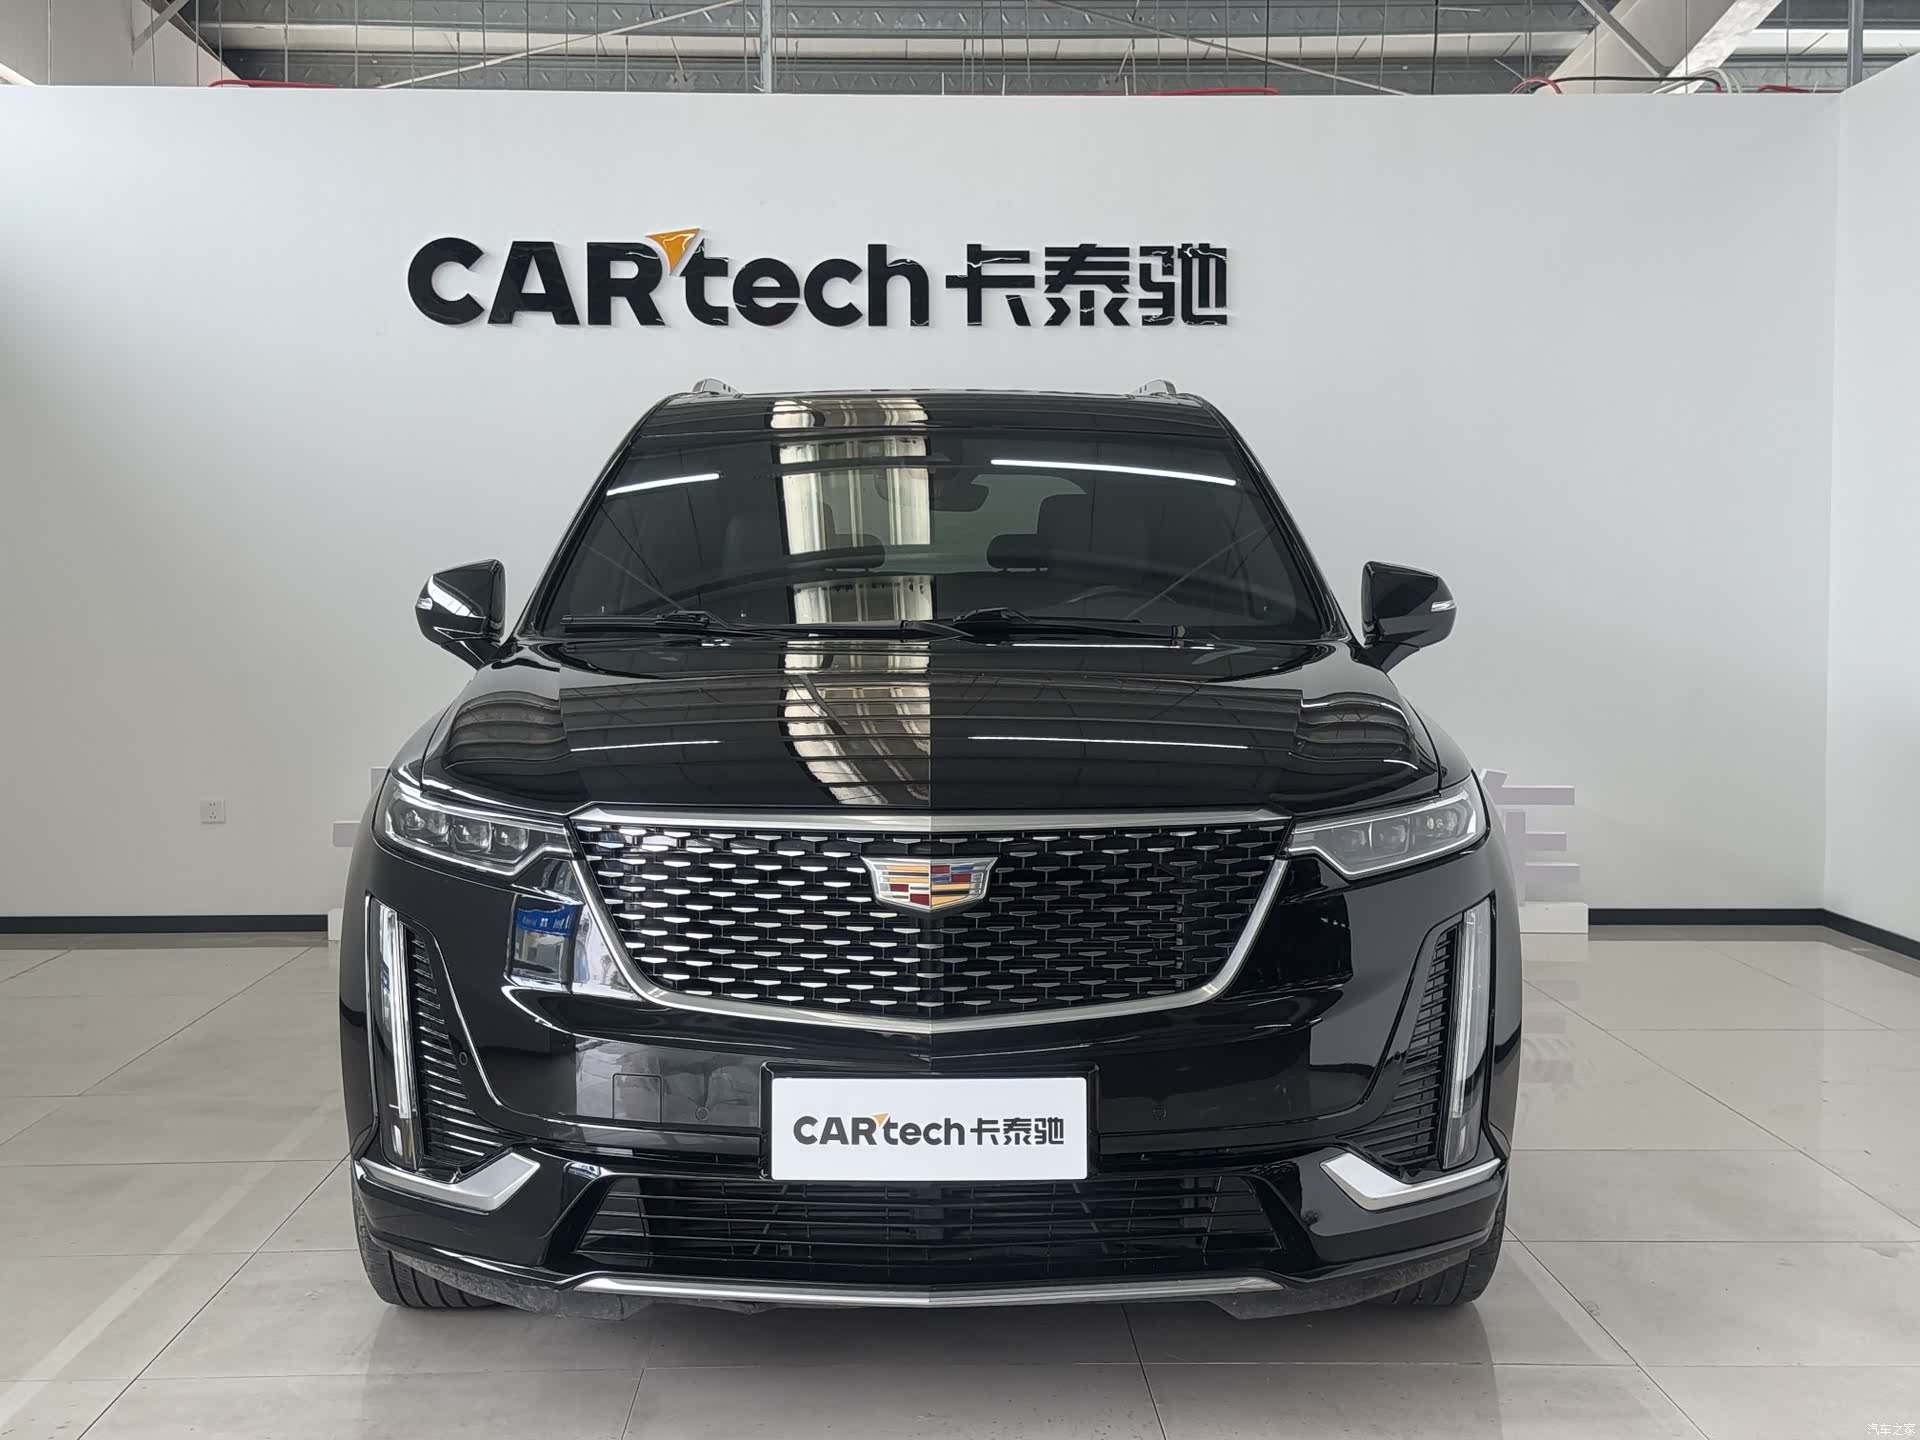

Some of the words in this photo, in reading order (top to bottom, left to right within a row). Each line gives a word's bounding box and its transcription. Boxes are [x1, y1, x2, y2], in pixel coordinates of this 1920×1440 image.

[407, 237, 930, 327] CARtech
[945, 243, 1228, 327] 卡泰驰
[793, 1115, 966, 1146] CARtech
[969, 1116, 1065, 1146] 卡泰驰
